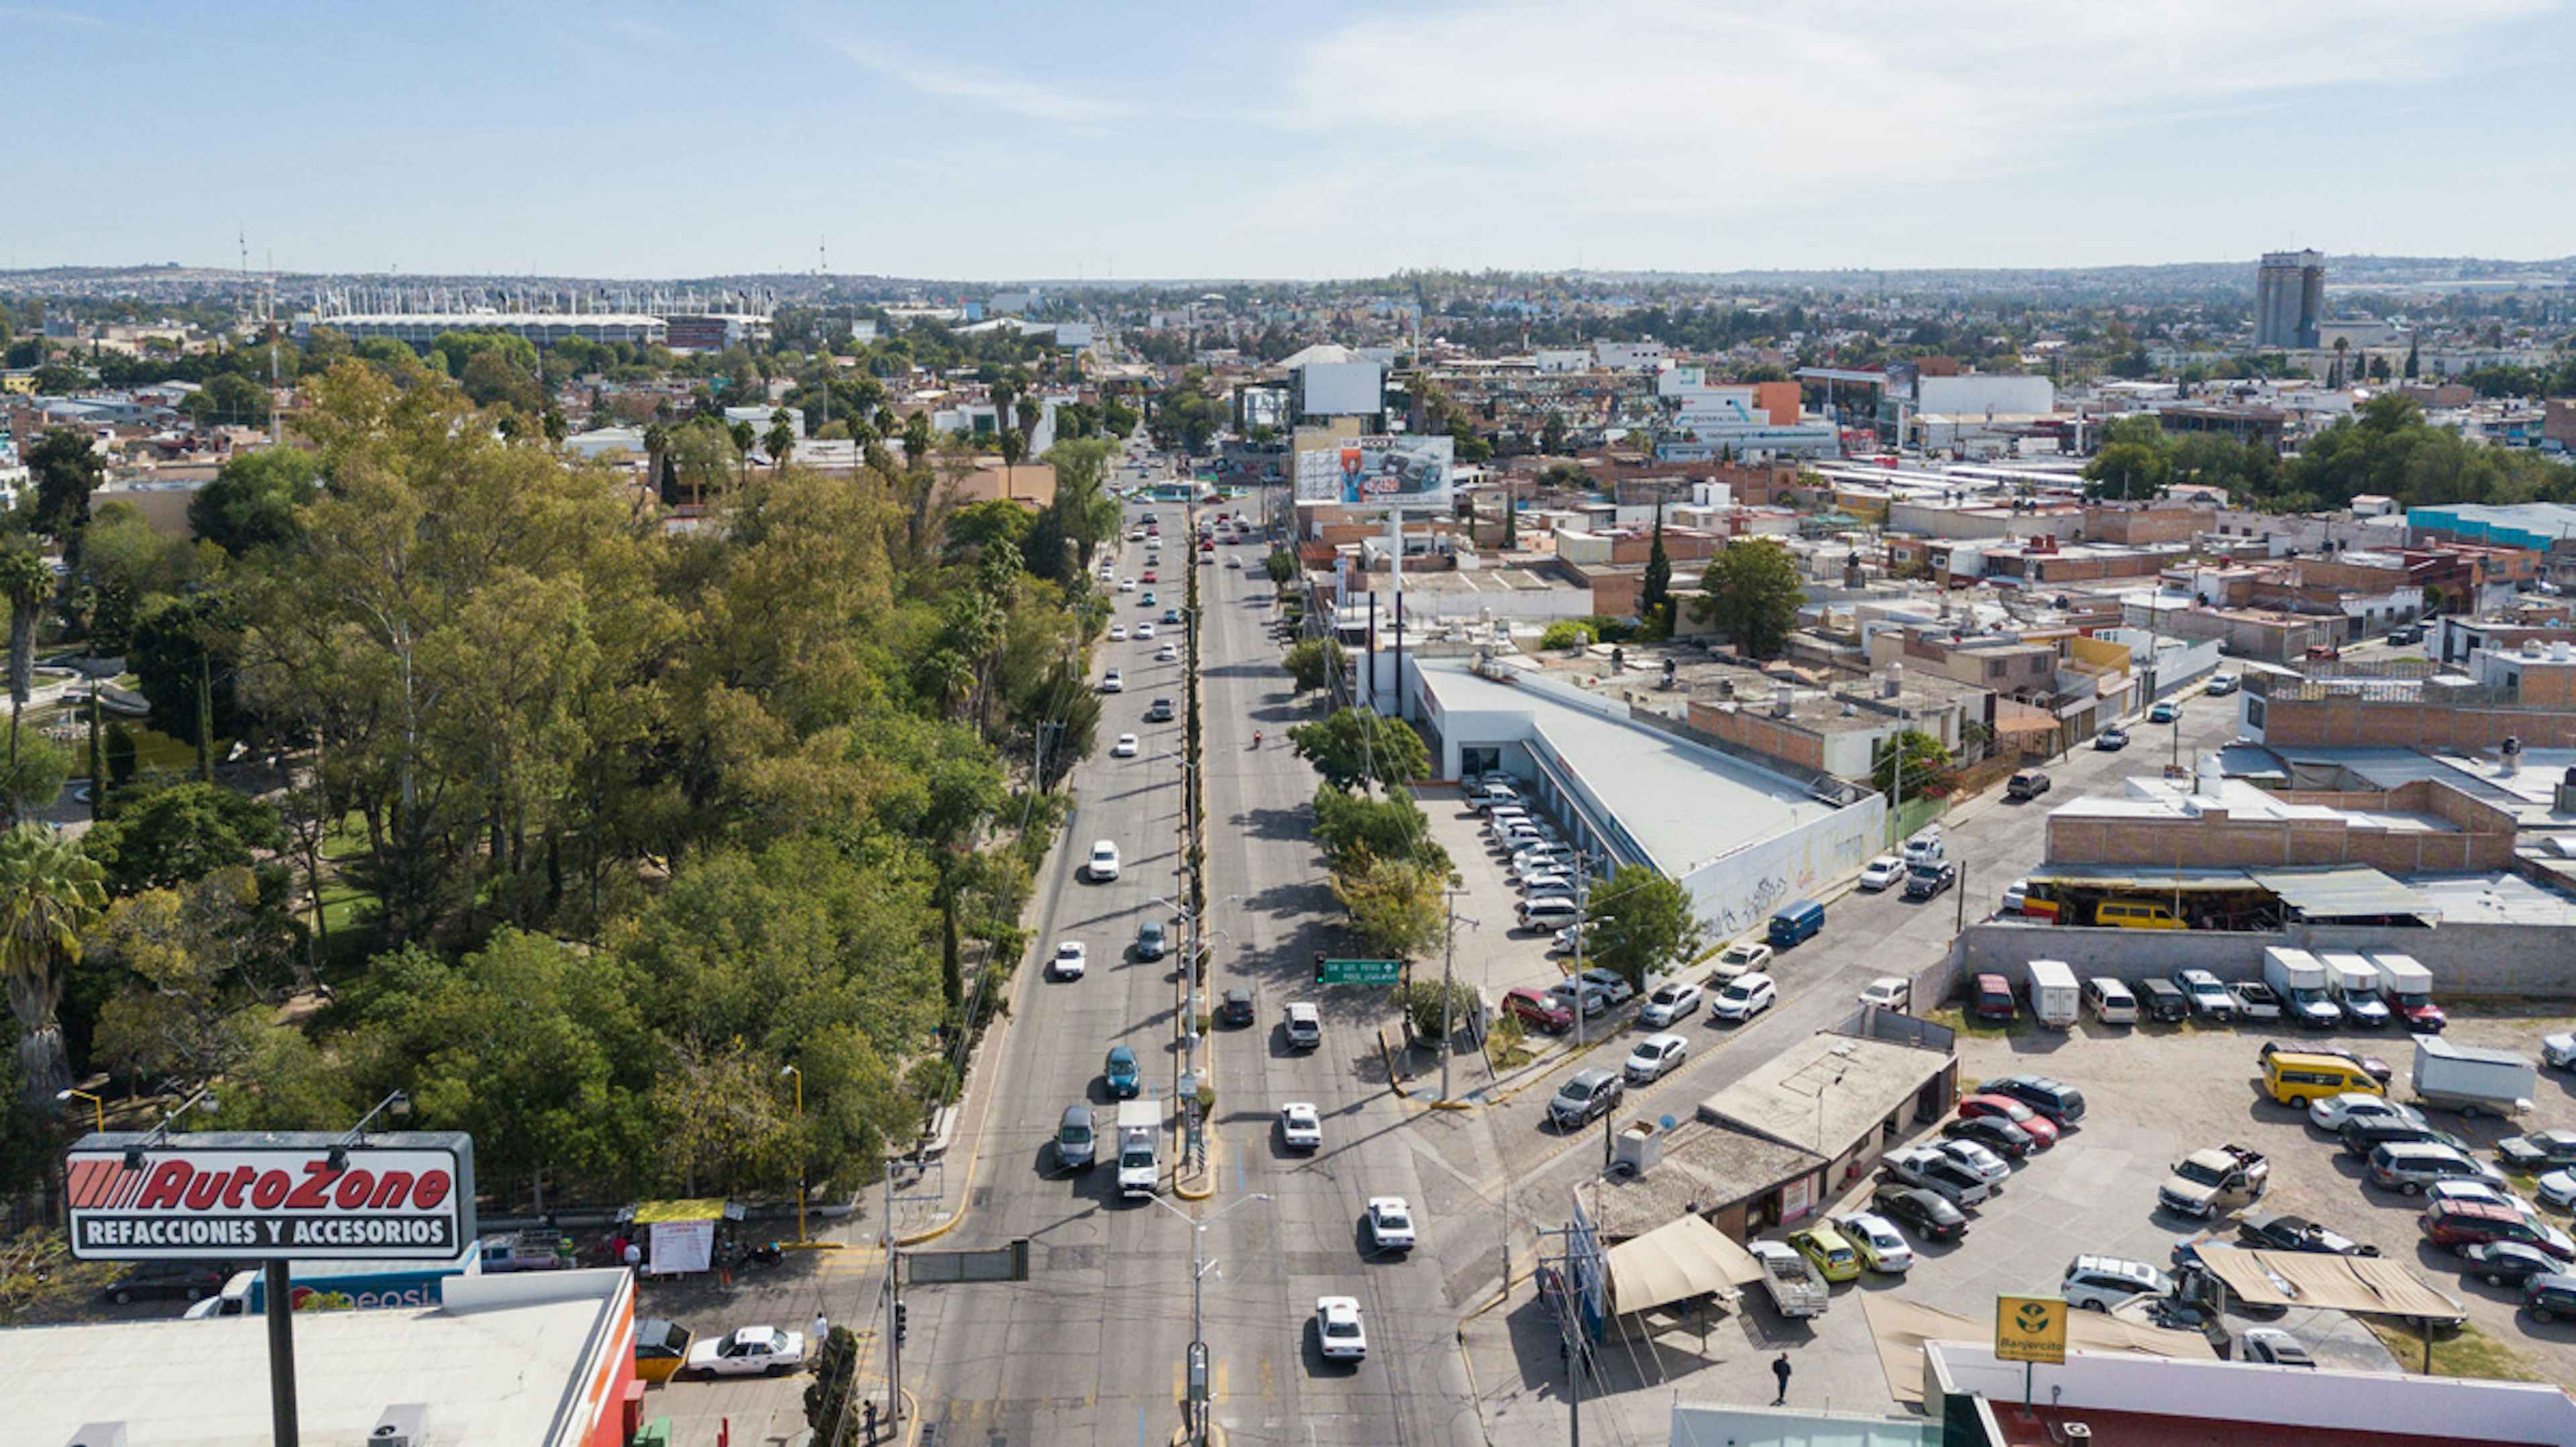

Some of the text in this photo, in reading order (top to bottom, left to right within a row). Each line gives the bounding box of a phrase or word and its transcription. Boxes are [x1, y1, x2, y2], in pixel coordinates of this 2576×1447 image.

[138, 1159, 451, 1209] AutoZone
[87, 1219, 444, 1244] REFACCIONES Y ACCESORIOS
